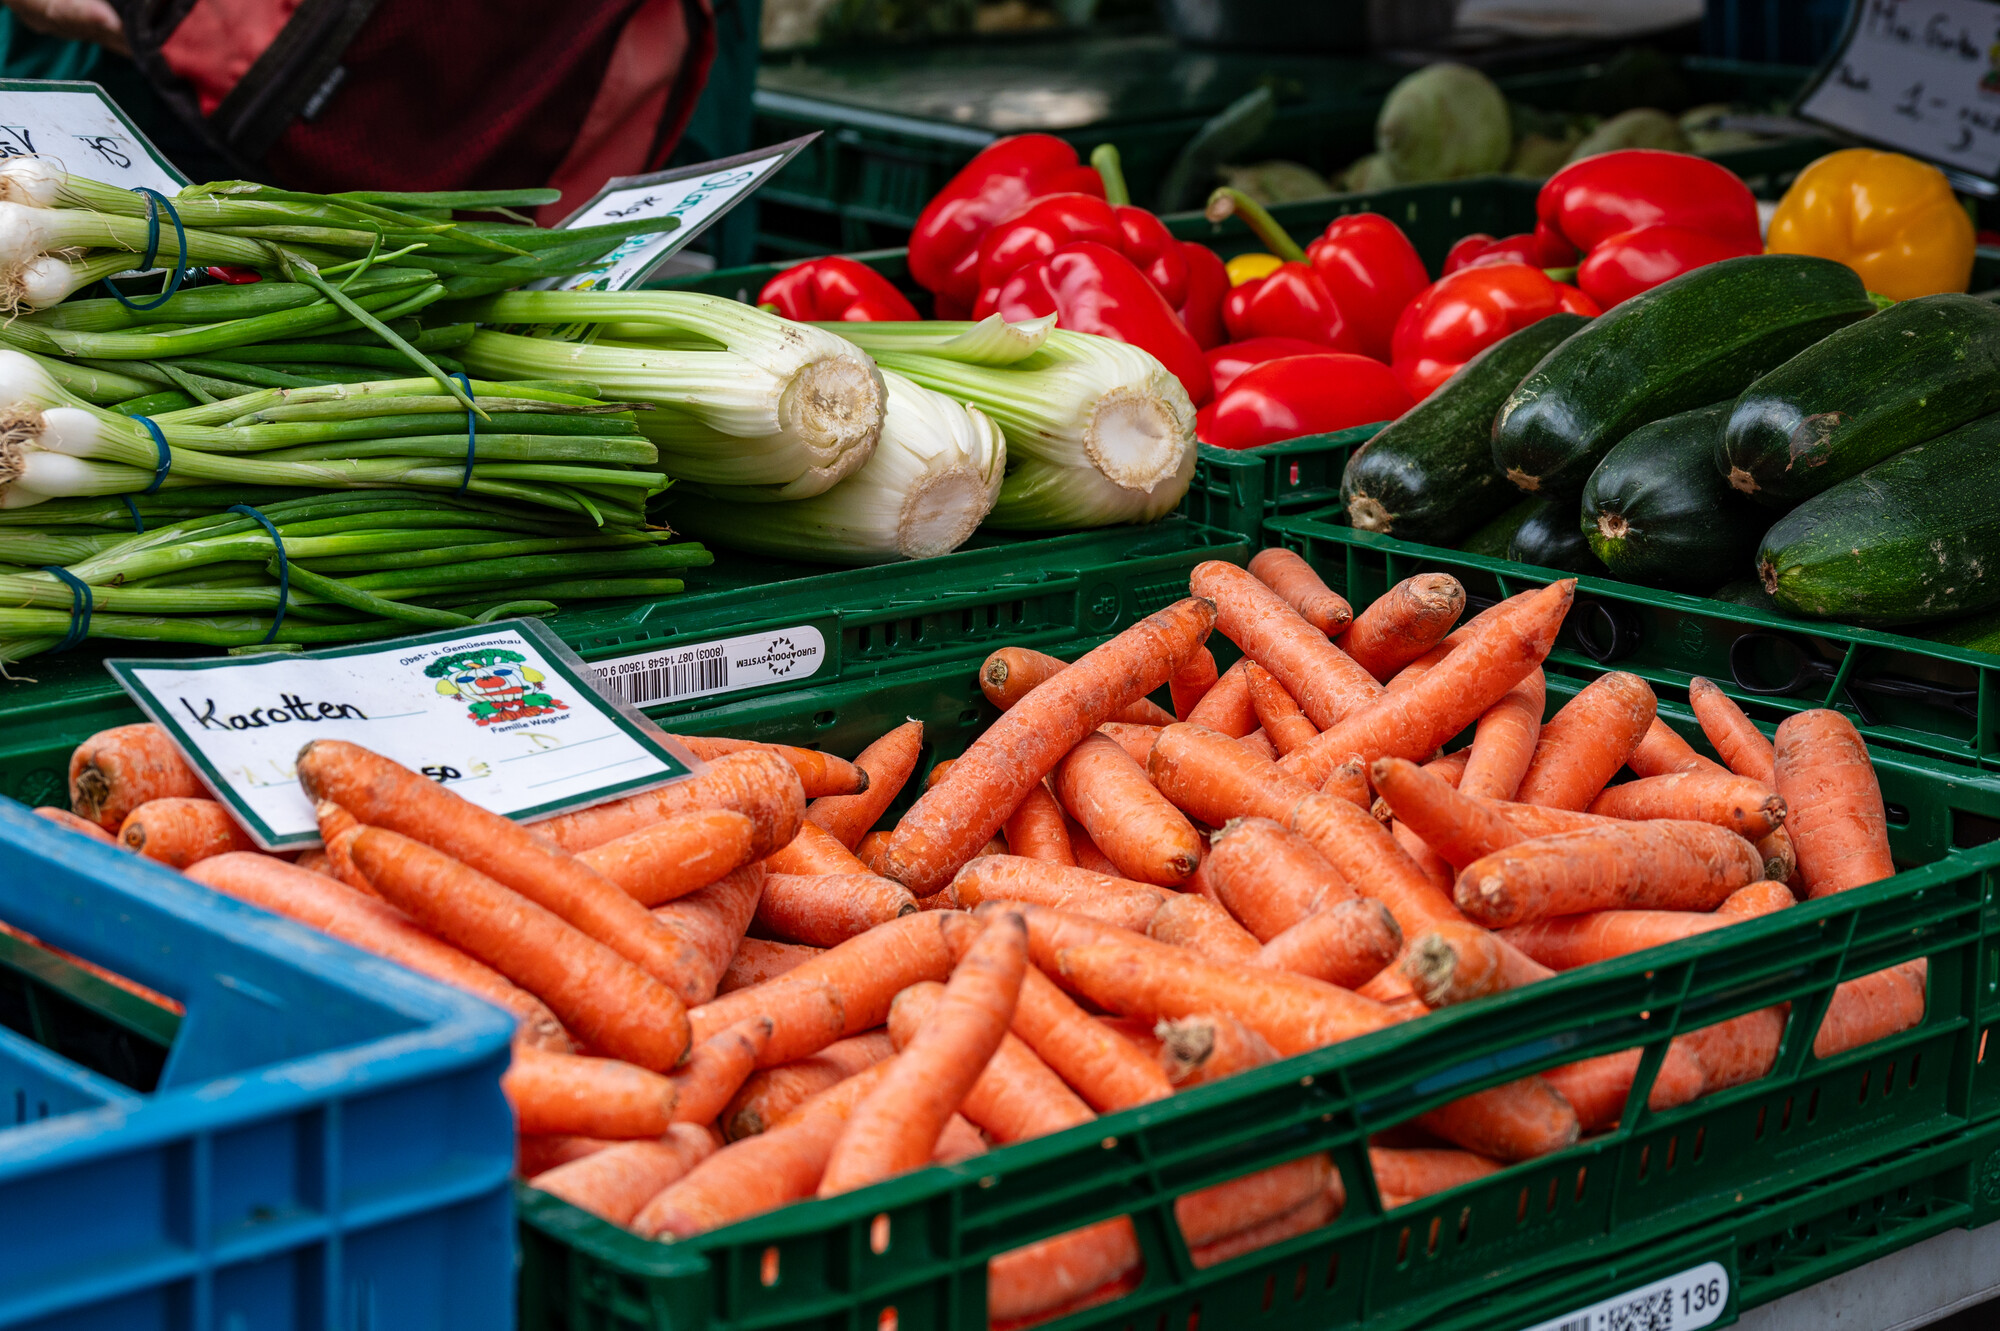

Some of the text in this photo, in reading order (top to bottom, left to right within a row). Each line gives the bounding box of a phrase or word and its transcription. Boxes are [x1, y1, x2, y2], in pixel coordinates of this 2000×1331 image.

[399, 638, 522, 667] Obst- u. Gemüseanbau
[677, 651, 694, 663] 087
[696, 644, 724, 660] (8003)
[618, 660, 646, 674] 13600
[648, 655, 675, 669] 14548
[610, 666, 617, 676] 9
[179, 693, 369, 731] Karotten
[490, 712, 571, 735] Familie Wagner
[1680, 1277, 1720, 1317] 136
